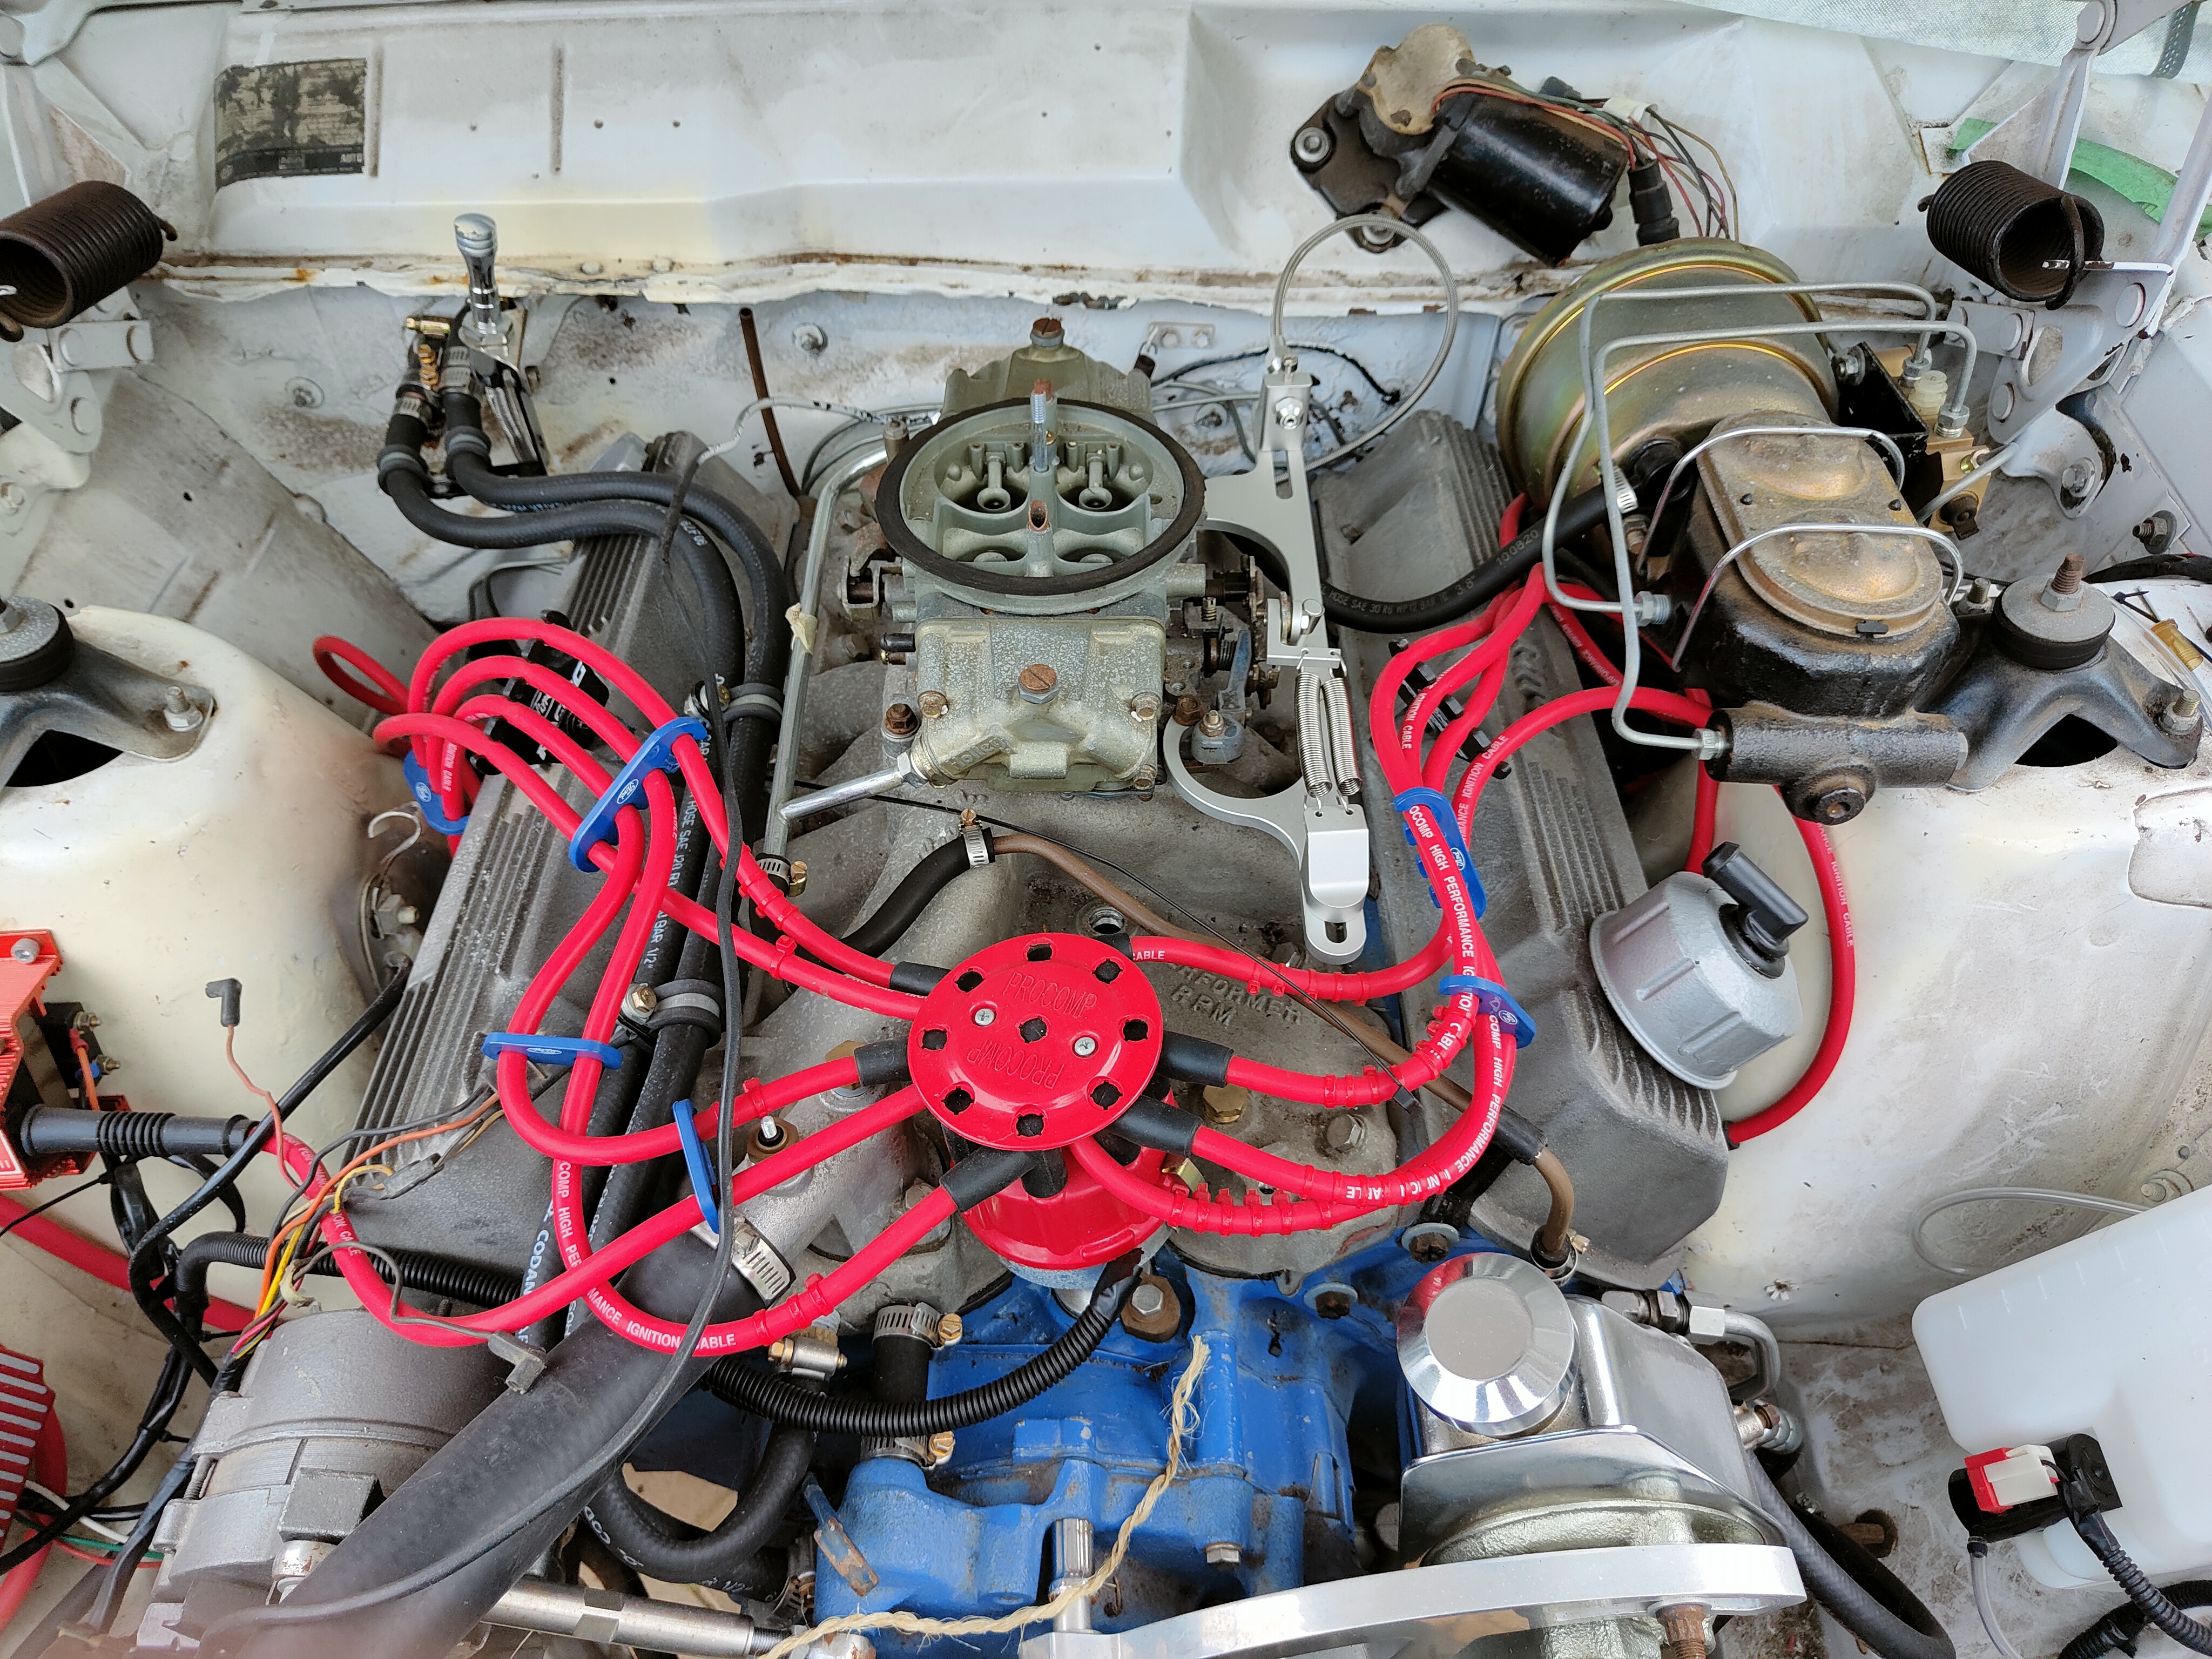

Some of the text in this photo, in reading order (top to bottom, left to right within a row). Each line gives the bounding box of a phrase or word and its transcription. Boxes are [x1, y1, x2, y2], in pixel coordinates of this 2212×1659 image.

[1495, 529, 1540, 567] 100820
[1401, 692, 1428, 750] IGNITION CABLE
[945, 737, 1006, 771] Holley
[1461, 762, 1485, 799] IGNITION
[1481, 735, 1509, 759] CABLE
[618, 780, 637, 802] Ford
[676, 830, 691, 852] SAE
[1410, 805, 1434, 839] OCOMP
[1429, 844, 1451, 871] HIGH
[1444, 875, 1475, 959] PERFORMANCE
[1831, 861, 1854, 948] IGNITION CABLE
[651, 920, 668, 944] BAR
[1003, 971, 1100, 1019] PROCOMP
[1170, 984, 1237, 1026] RPM
[1489, 1014, 1502, 1050] COMP
[967, 1038, 1065, 1090] PROCOMP
[1493, 1056, 1503, 1088] HIGH
[1454, 1093, 1502, 1173] PERFORMANCE
[557, 1161, 571, 1198] COMP
[558, 1206, 574, 1239] HIGH
[523, 1230, 550, 1295] CODAN
[626, 1320, 681, 1348] IGNITION
[583, 1505, 611, 1544] COD
